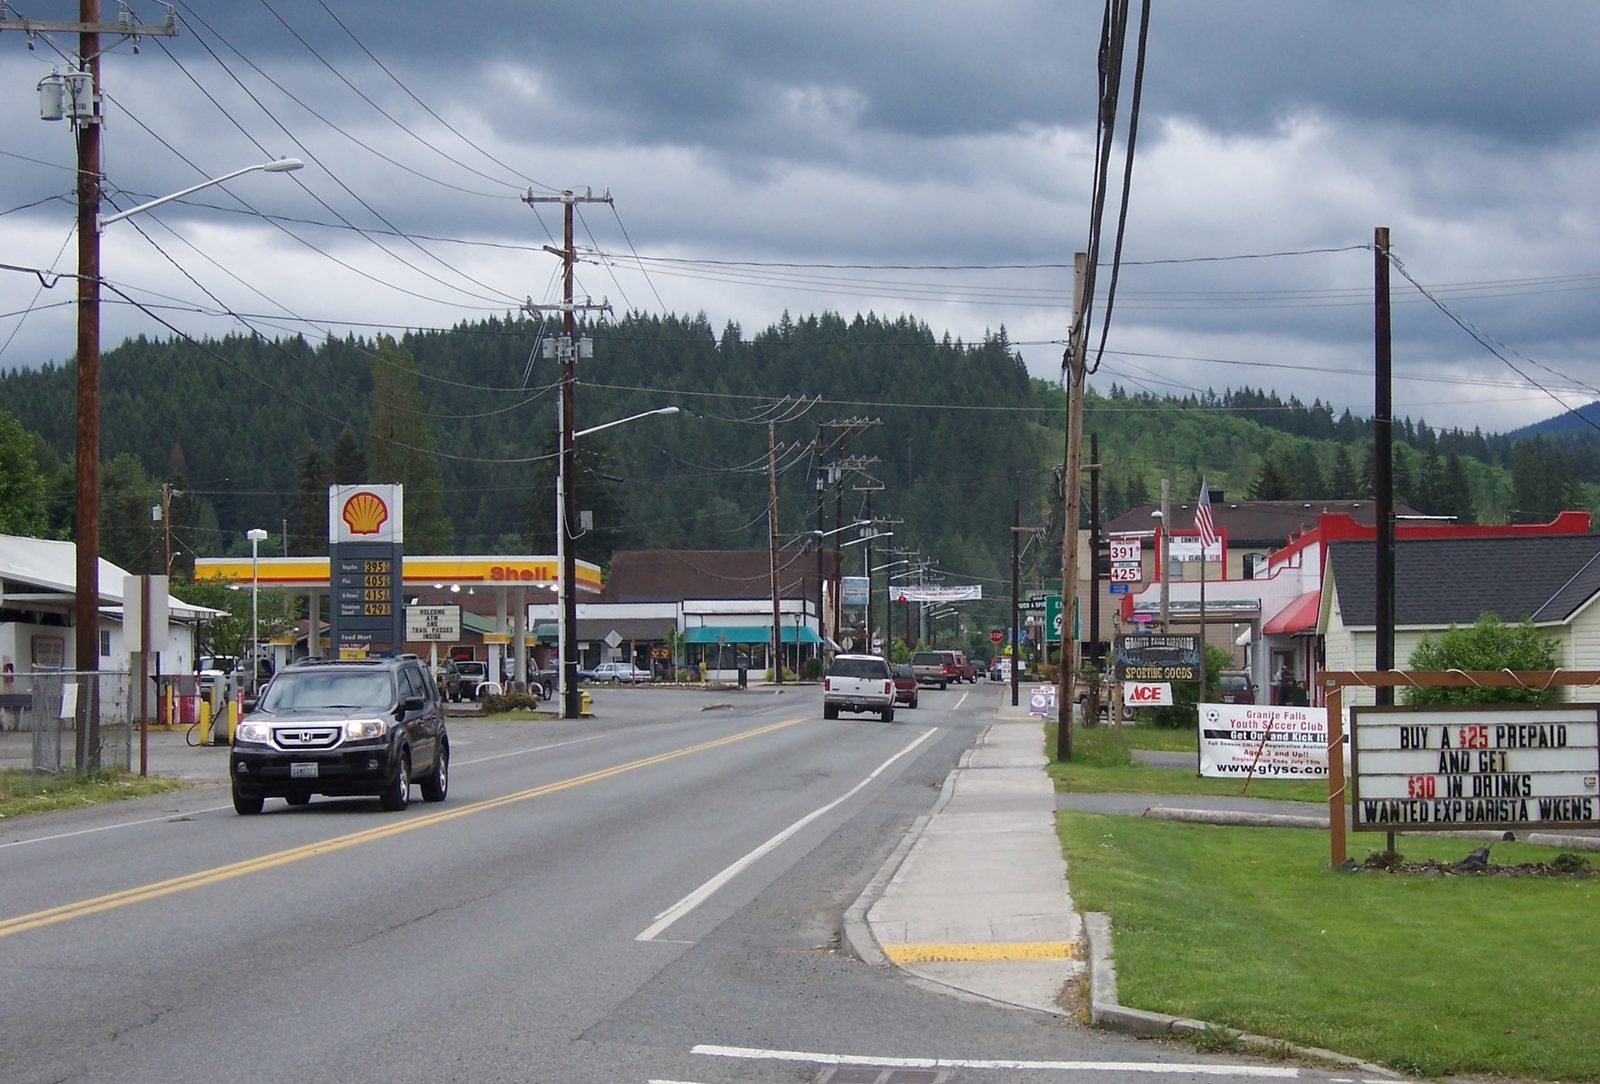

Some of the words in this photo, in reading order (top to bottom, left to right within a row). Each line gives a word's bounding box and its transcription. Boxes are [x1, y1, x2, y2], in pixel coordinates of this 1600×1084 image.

[1112, 547, 1133, 558] 391
[490, 566, 547, 580] Shell
[1112, 569, 1135, 580] 425
[366, 576, 383, 586] 405
[366, 590, 383, 600] 415
[366, 604, 383, 614] 429
[1125, 667, 1162, 679] SPORTING
[1164, 667, 1193, 679] GOODS
[1129, 685, 1161, 700] ACE
[1246, 710, 1280, 719] Granite
[1284, 712, 1307, 720] Falls
[1230, 719, 1258, 729] Youth
[1262, 720, 1296, 730] Soccer
[1300, 721, 1323, 731] Club
[1230, 731, 1248, 740] Get
[1270, 733, 1289, 741] and
[1292, 733, 1314, 742] Kick
[1400, 726, 1428, 749] BUY
[1441, 727, 1450, 748] A
[1459, 726, 1488, 749] $25
[1496, 725, 1567, 748] PREPAID
[1438, 751, 1470, 773] AND
[1479, 751, 1507, 773] GET
[1407, 776, 1436, 799] $30
[1447, 775, 1463, 797] IN
[1473, 774, 1531, 797] DRINKS
[1364, 800, 1429, 823] WANTED
[1434, 800, 1462, 822] EXP
[1465, 799, 1529, 822] BARISTA
[1539, 799, 1592, 821] WKENS
